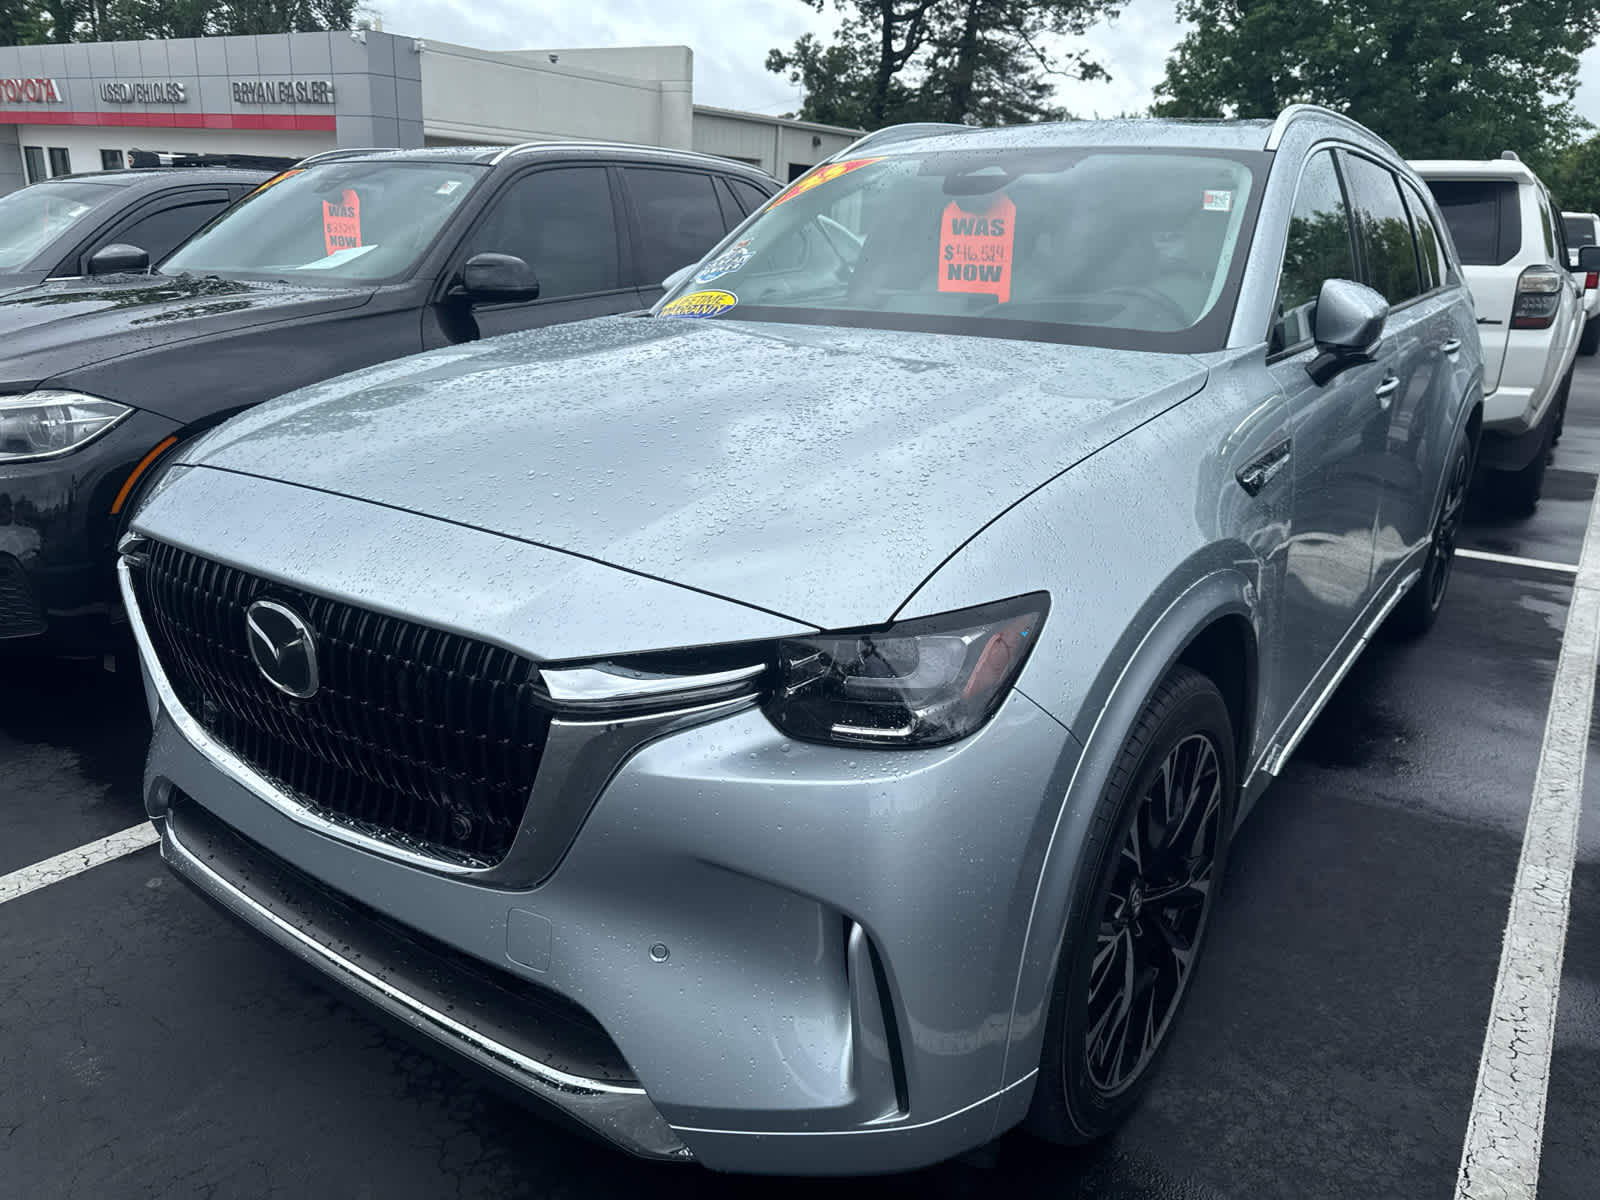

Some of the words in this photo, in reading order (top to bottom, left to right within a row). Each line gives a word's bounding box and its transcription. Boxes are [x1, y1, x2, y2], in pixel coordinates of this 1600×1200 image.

[100, 83, 128, 102] USED
[128, 82, 185, 103] VEHICLES
[232, 82, 275, 103] BRYAN
[277, 81, 334, 103] EASLER
[328, 205, 355, 217] WAS
[952, 218, 1005, 236] WAS
[330, 235, 356, 247] NOW
[947, 263, 1003, 282] NOW
